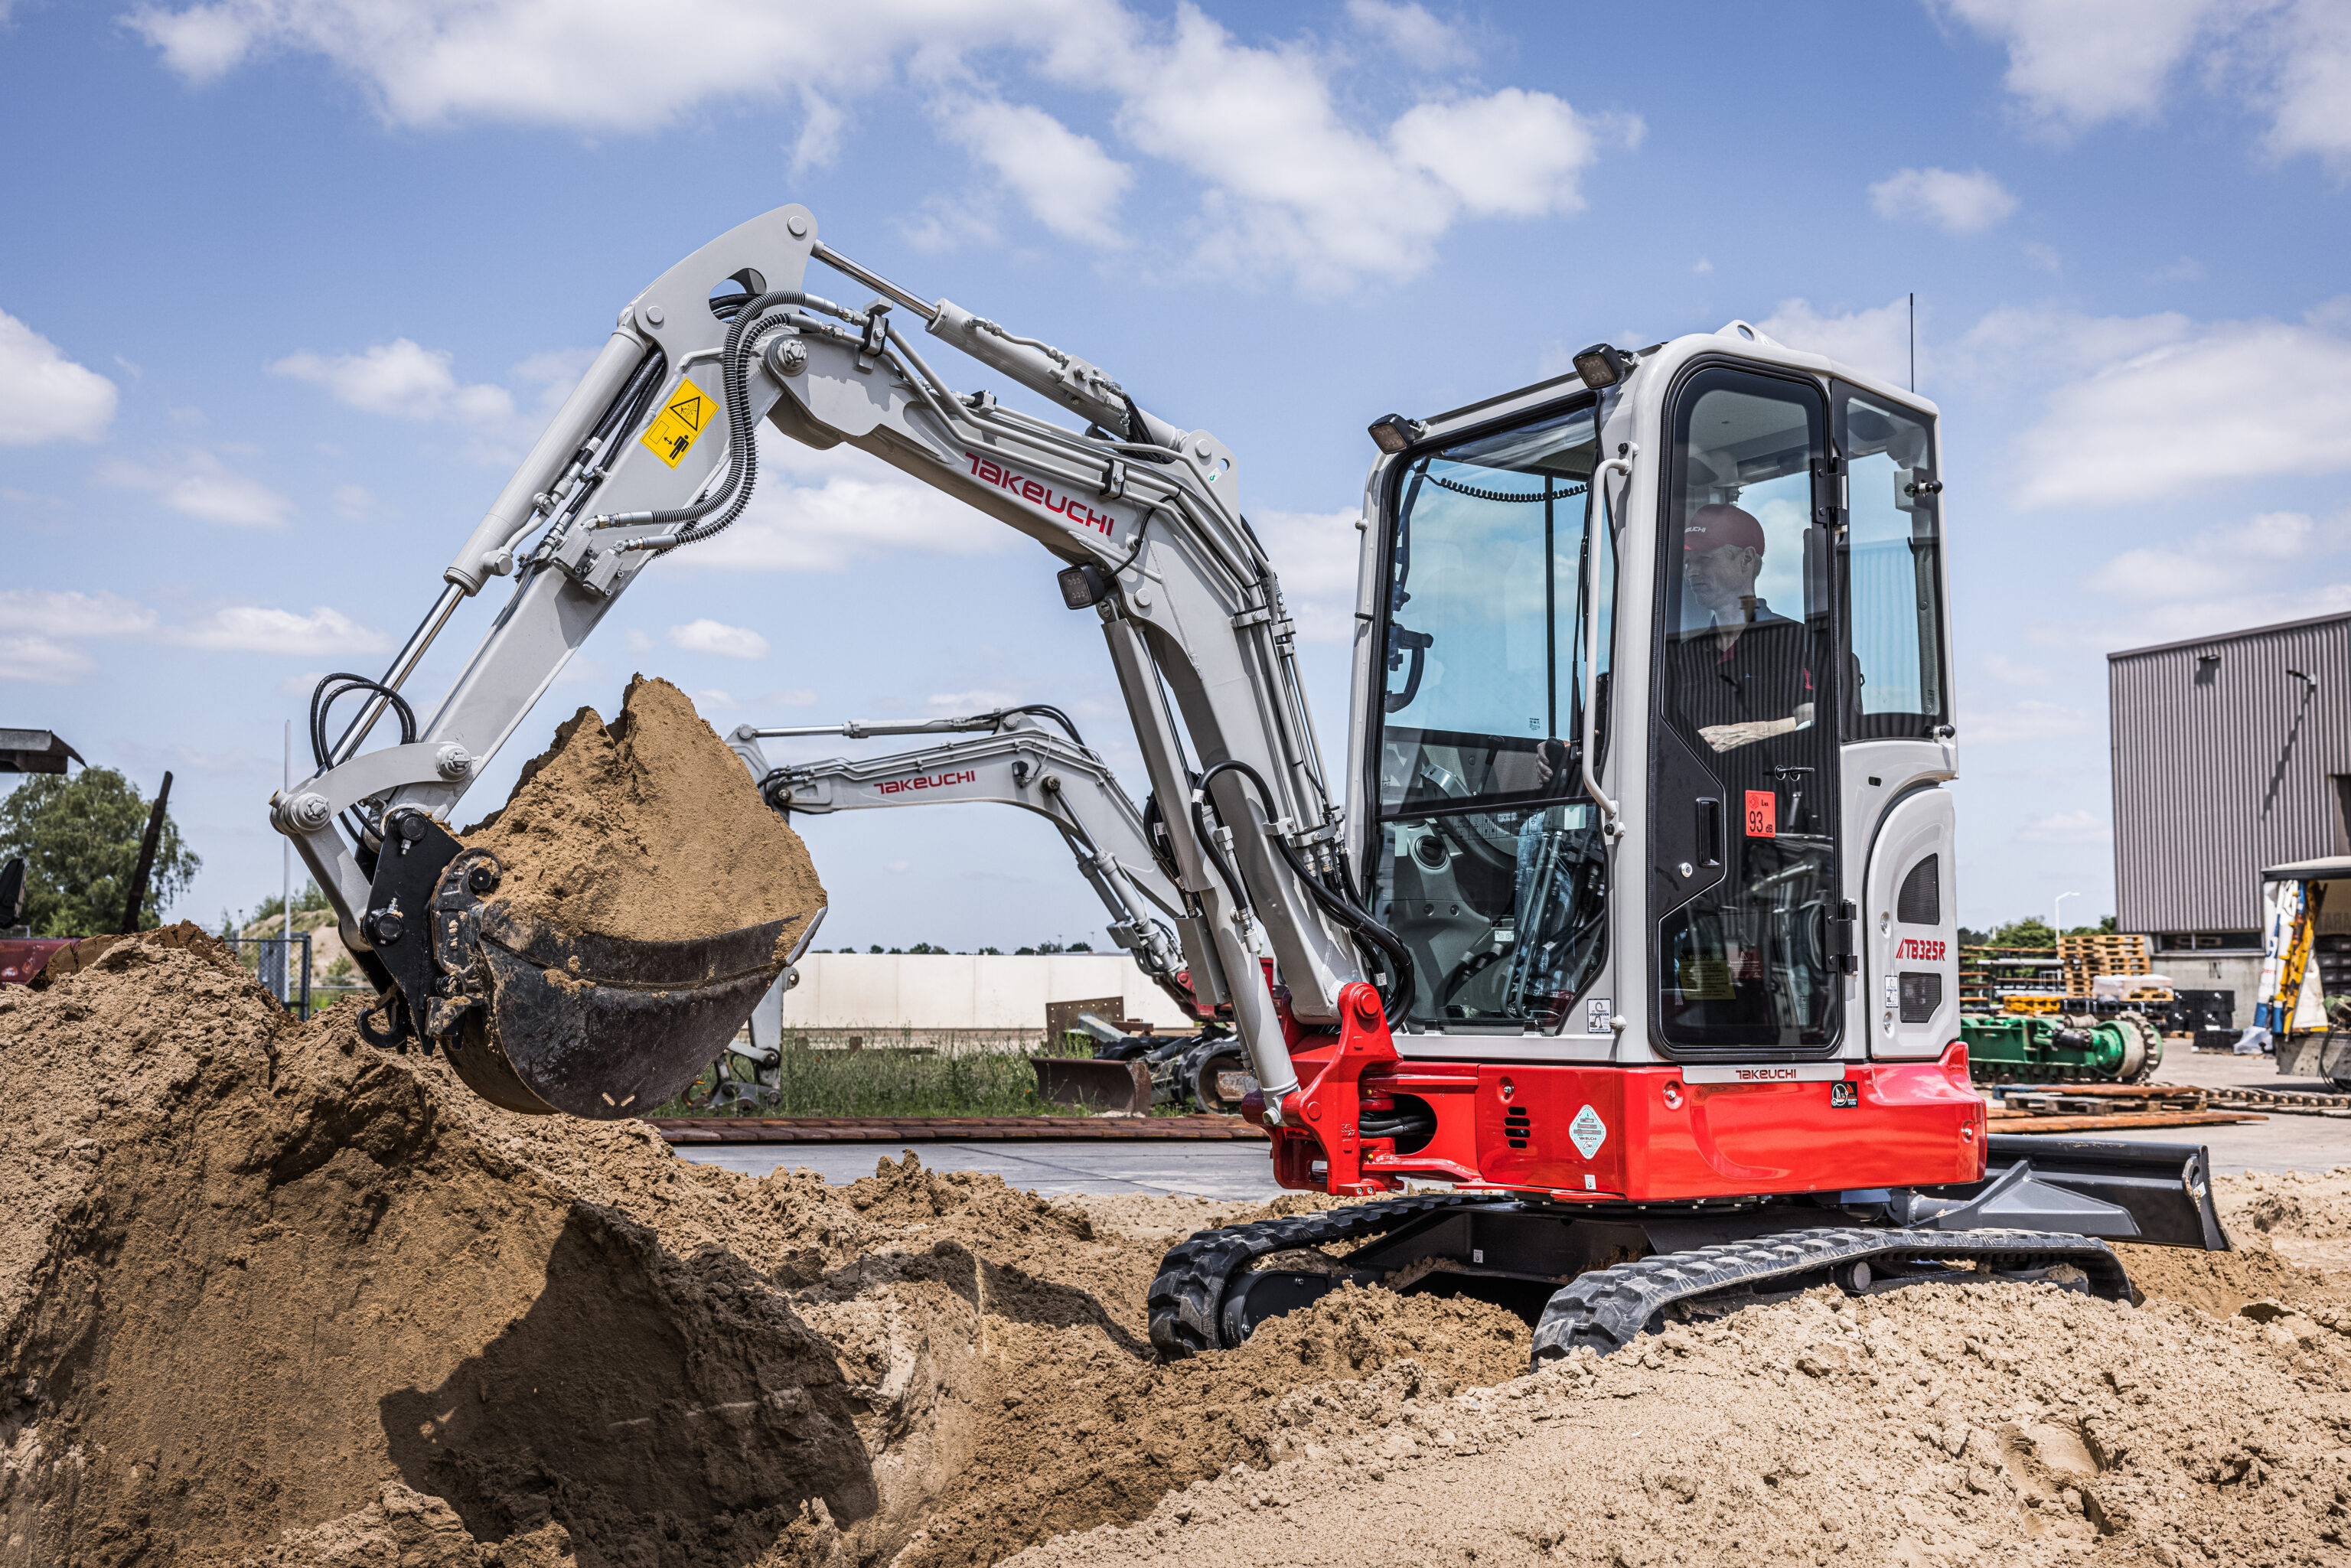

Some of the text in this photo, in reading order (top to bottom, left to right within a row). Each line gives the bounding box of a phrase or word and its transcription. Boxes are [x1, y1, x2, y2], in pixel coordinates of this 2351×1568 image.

[965, 451, 1114, 536] TAKEUCHI
[873, 770, 976, 794] TAKEUCHI
[1749, 810, 1773, 833] 93 dB
[1904, 939, 1945, 961] TB325R
[1735, 1068, 1796, 1080] TAKEUCHI
